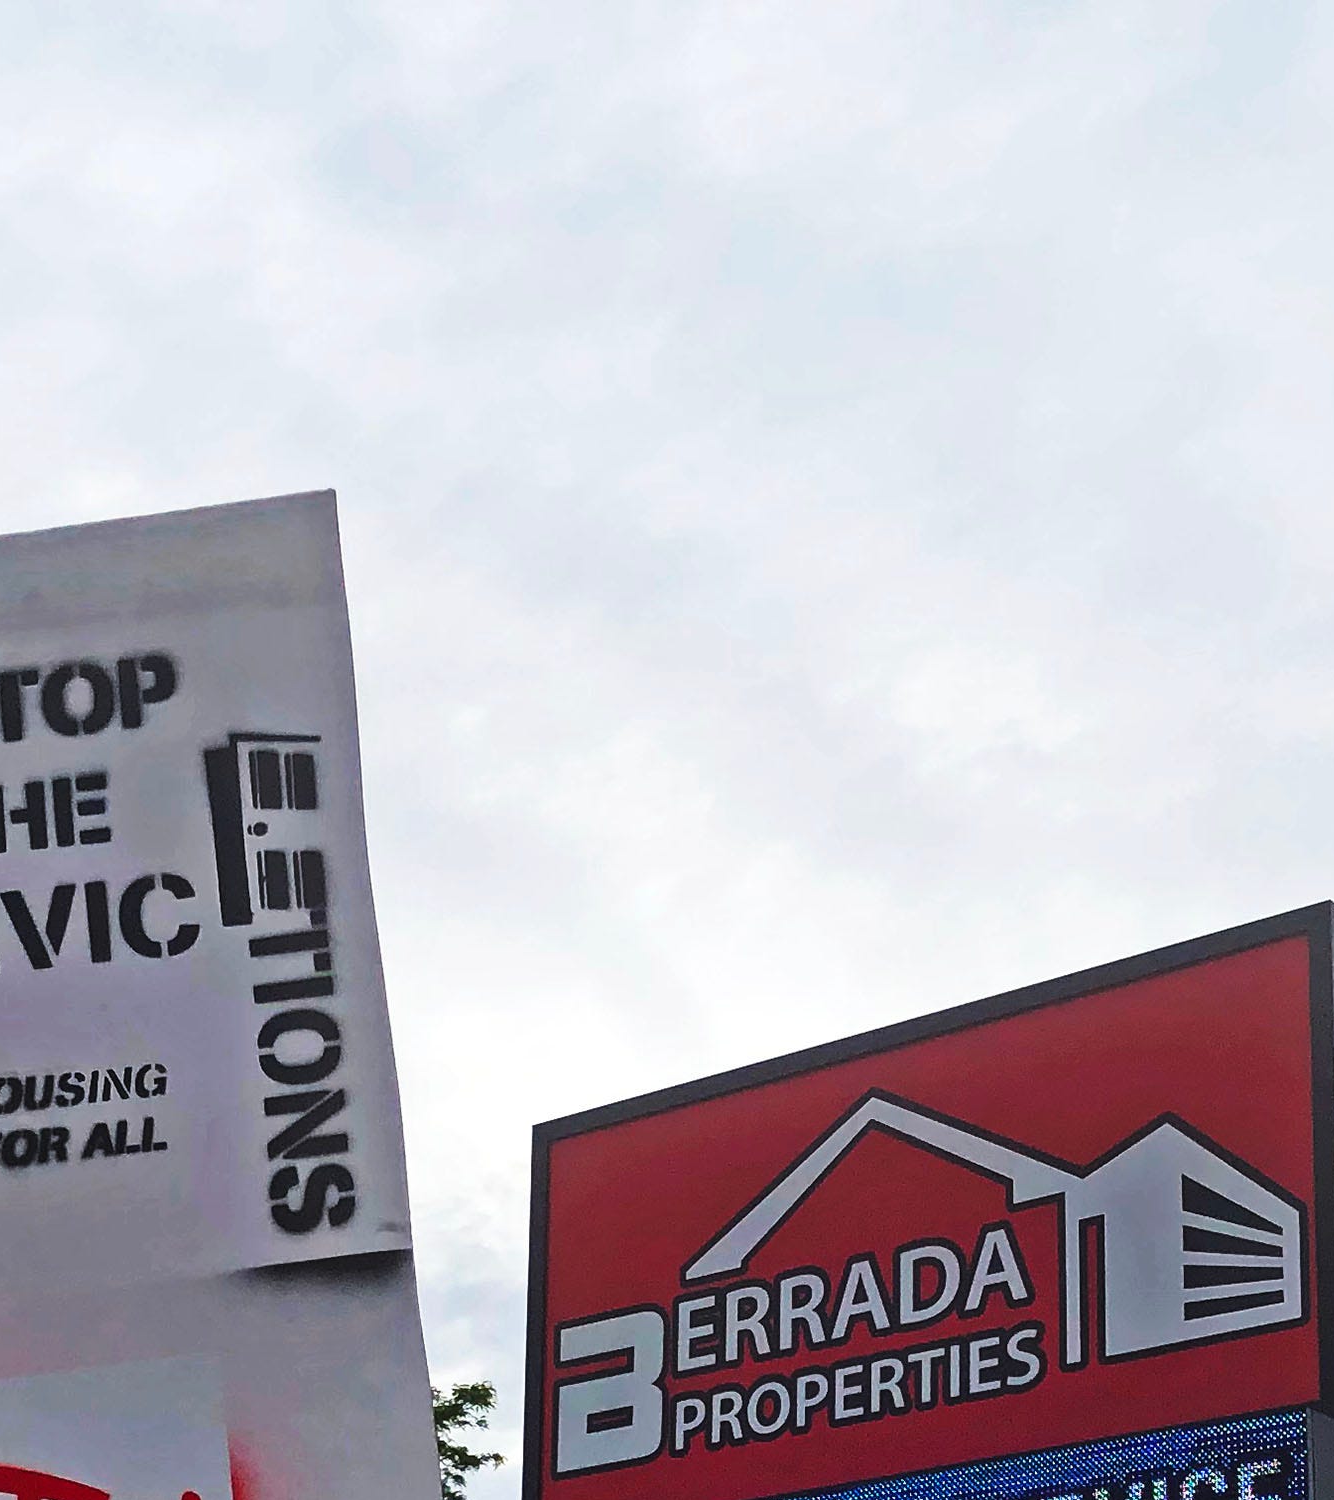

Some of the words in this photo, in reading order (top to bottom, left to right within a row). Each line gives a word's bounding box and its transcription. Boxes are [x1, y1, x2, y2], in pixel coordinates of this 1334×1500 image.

[80, 1115, 169, 1162] ALL
[552, 1228, 1031, 1475] BERRADA
[674, 1328, 1043, 1453] PROPERTIES
